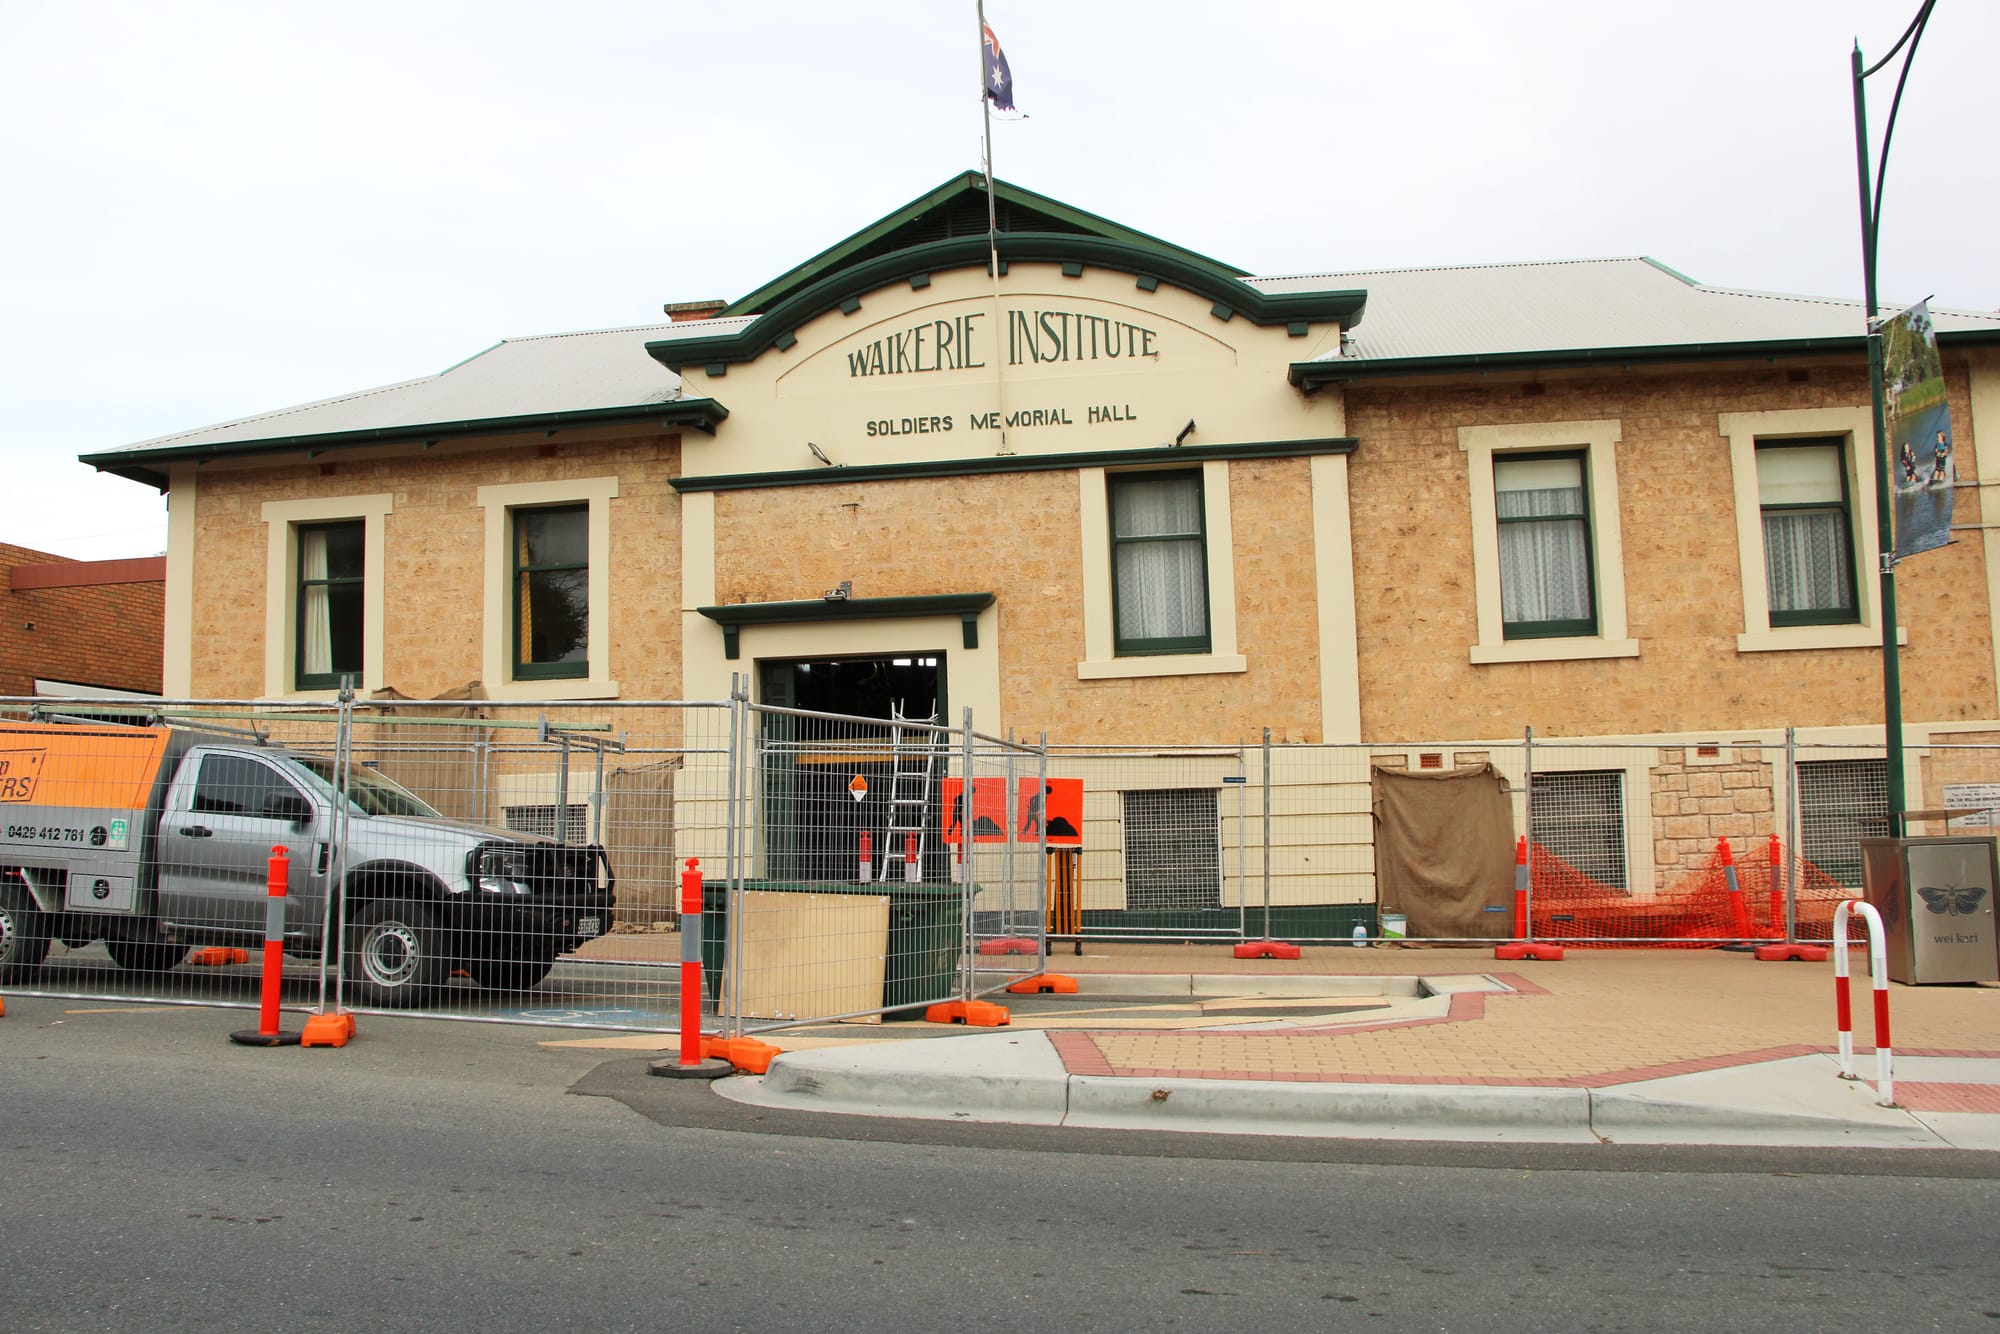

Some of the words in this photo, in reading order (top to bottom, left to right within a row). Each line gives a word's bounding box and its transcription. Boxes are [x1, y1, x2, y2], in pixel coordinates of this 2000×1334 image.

[848, 313, 985, 377] WAIKERIE
[1008, 310, 1159, 365] INSTITUTE
[866, 415, 953, 436] SOLDIERS
[970, 408, 1073, 430] MEMORIAL
[1088, 404, 1137, 424] HALL
[0, 776, 31, 798] RS
[8, 825, 36, 839] 0429
[39, 827, 61, 840] 412
